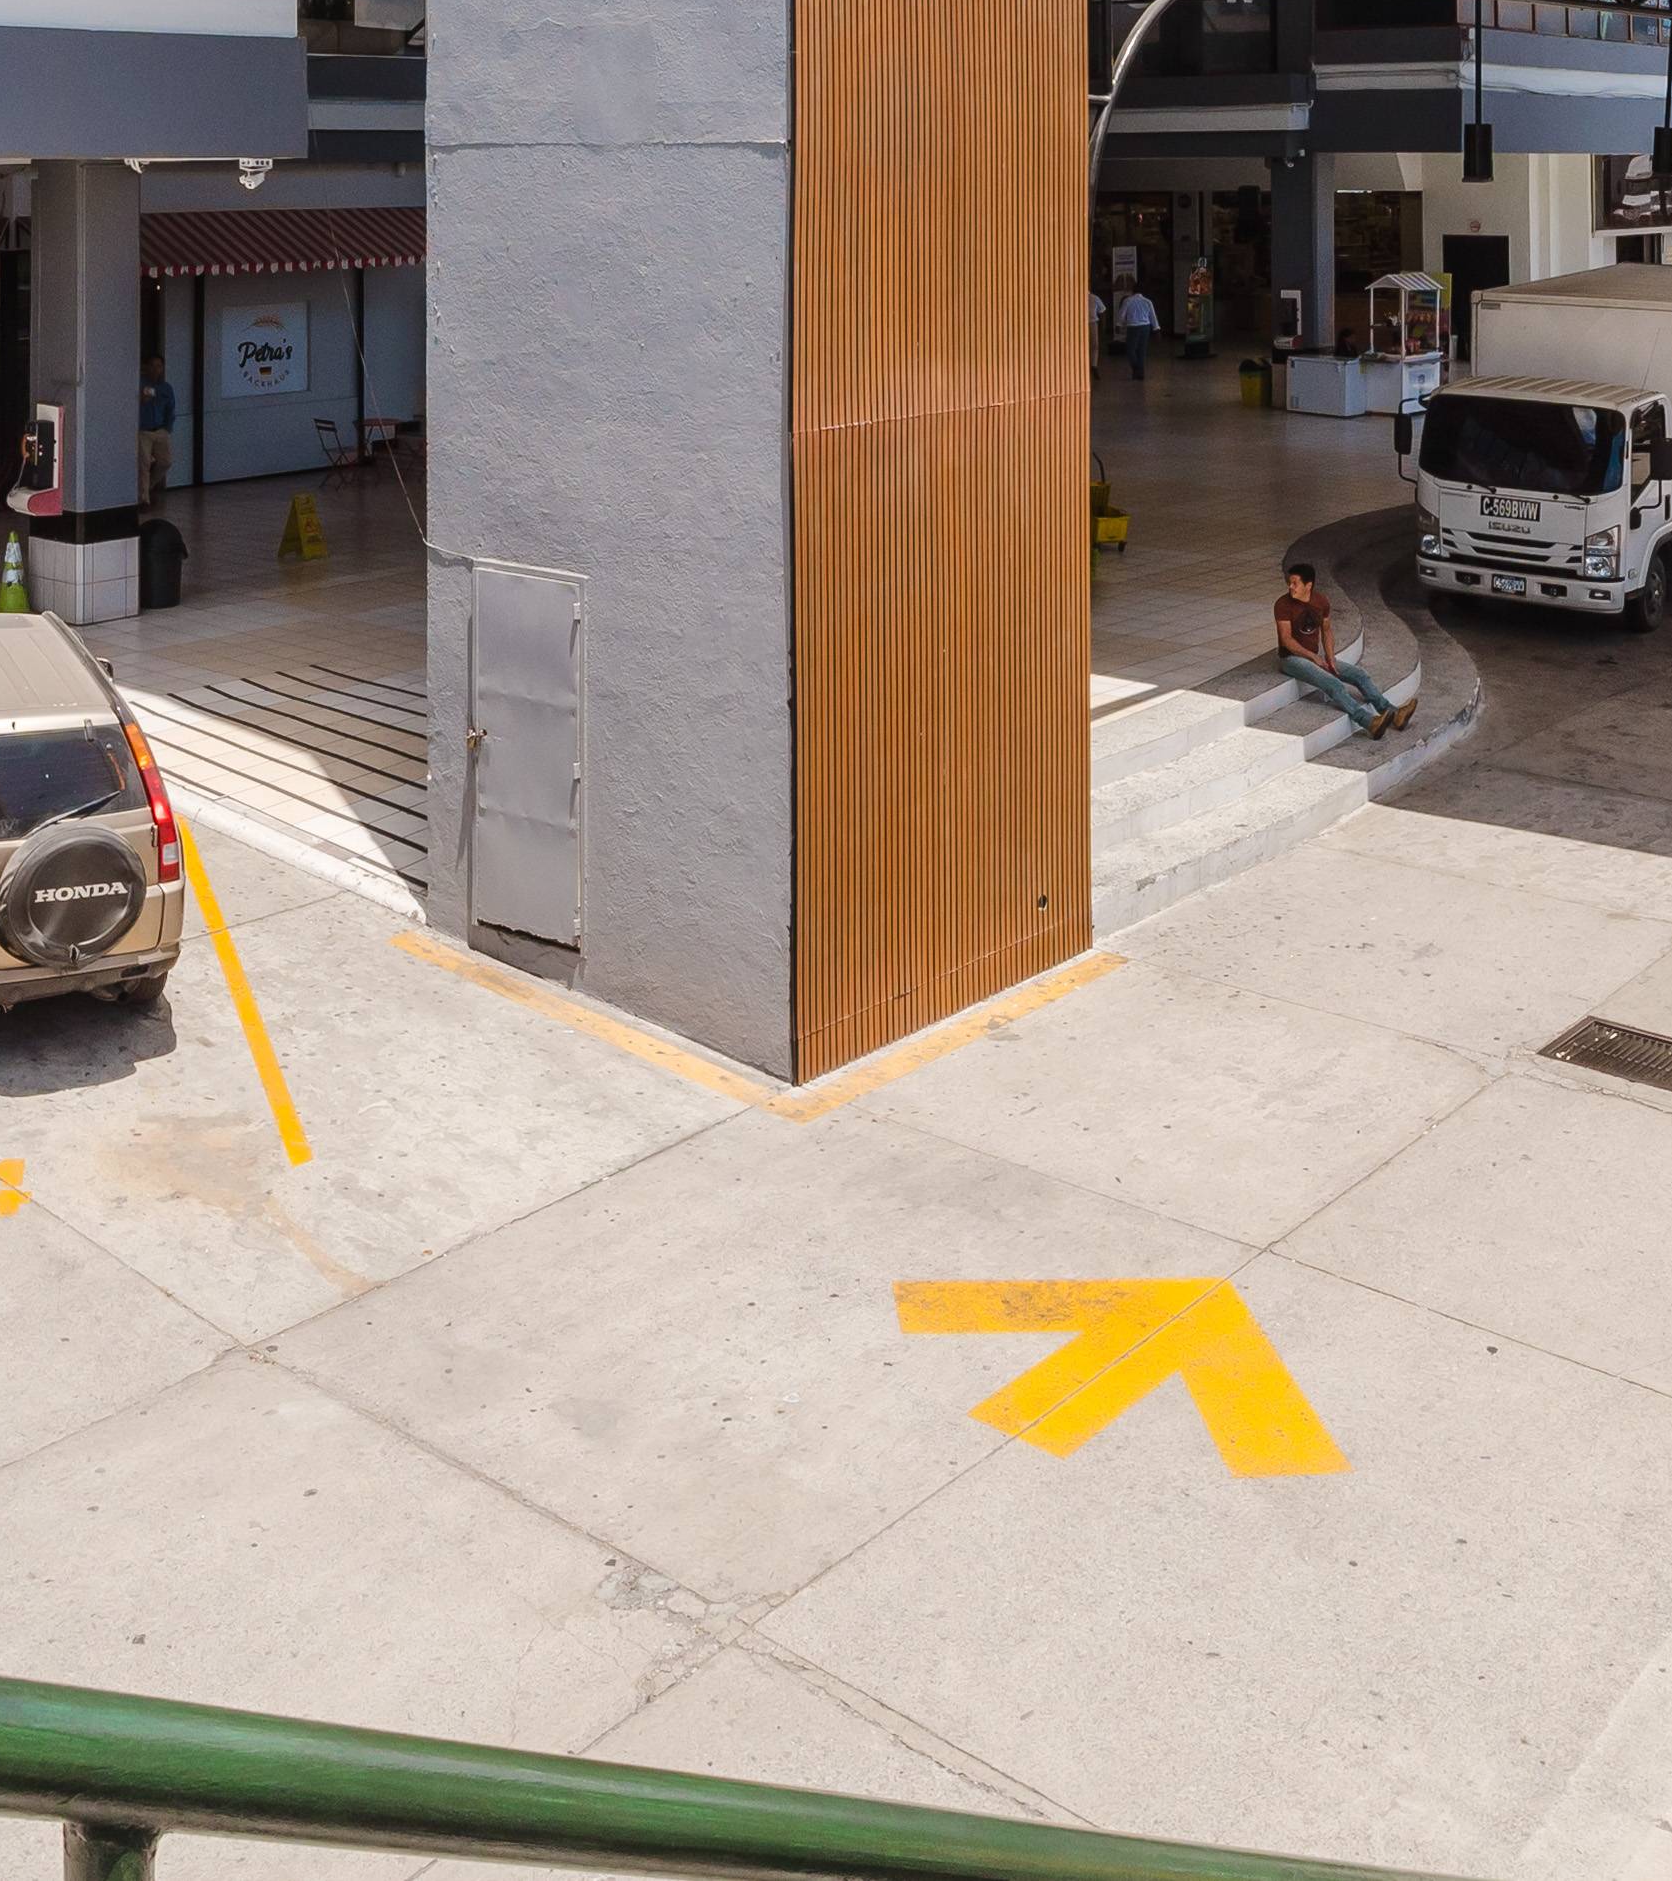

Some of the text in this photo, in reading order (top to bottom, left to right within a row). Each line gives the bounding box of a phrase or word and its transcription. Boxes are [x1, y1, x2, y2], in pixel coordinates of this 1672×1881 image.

[237, 338, 293, 368] Petra's
[1482, 497, 1539, 520] C-569BWW
[1488, 520, 1531, 534] ISUZU
[34, 881, 128, 903] HONDA
